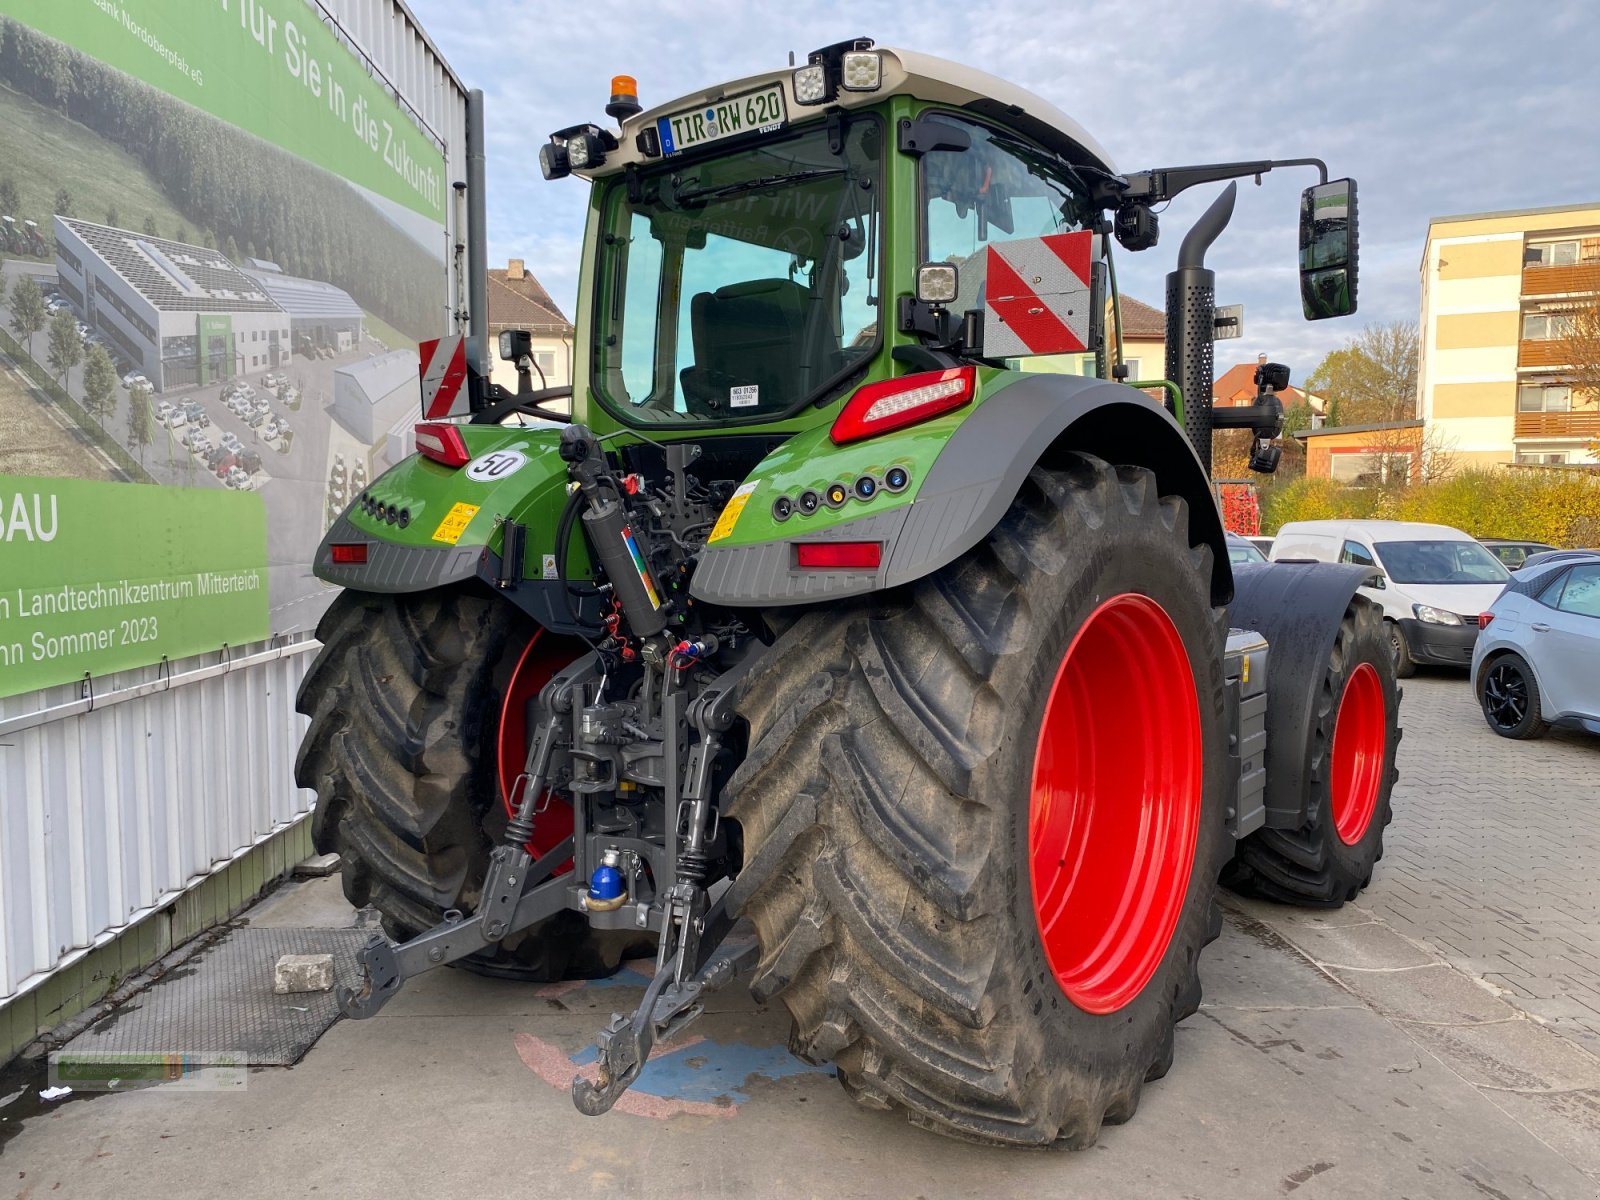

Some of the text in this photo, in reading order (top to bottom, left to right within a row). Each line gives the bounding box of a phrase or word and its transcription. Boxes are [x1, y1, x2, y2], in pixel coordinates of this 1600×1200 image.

[122, 9, 190, 77] Nordoberpfalz
[190, 69, 204, 86] eG
[285, 20, 321, 98] Sie
[327, 65, 347, 123] in
[353, 94, 379, 153] die
[383, 119, 441, 211] Zukunft!
[672, 91, 781, 146] TIR RW 620
[758, 122, 782, 135] FENDT
[473, 453, 516, 477] 50
[0, 493, 58, 542] AU
[18, 579, 194, 617] Landtechnikzentrum
[197, 570, 260, 597] Mitterteich
[31, 628, 116, 661] Sommer
[120, 616, 159, 646] 2023
